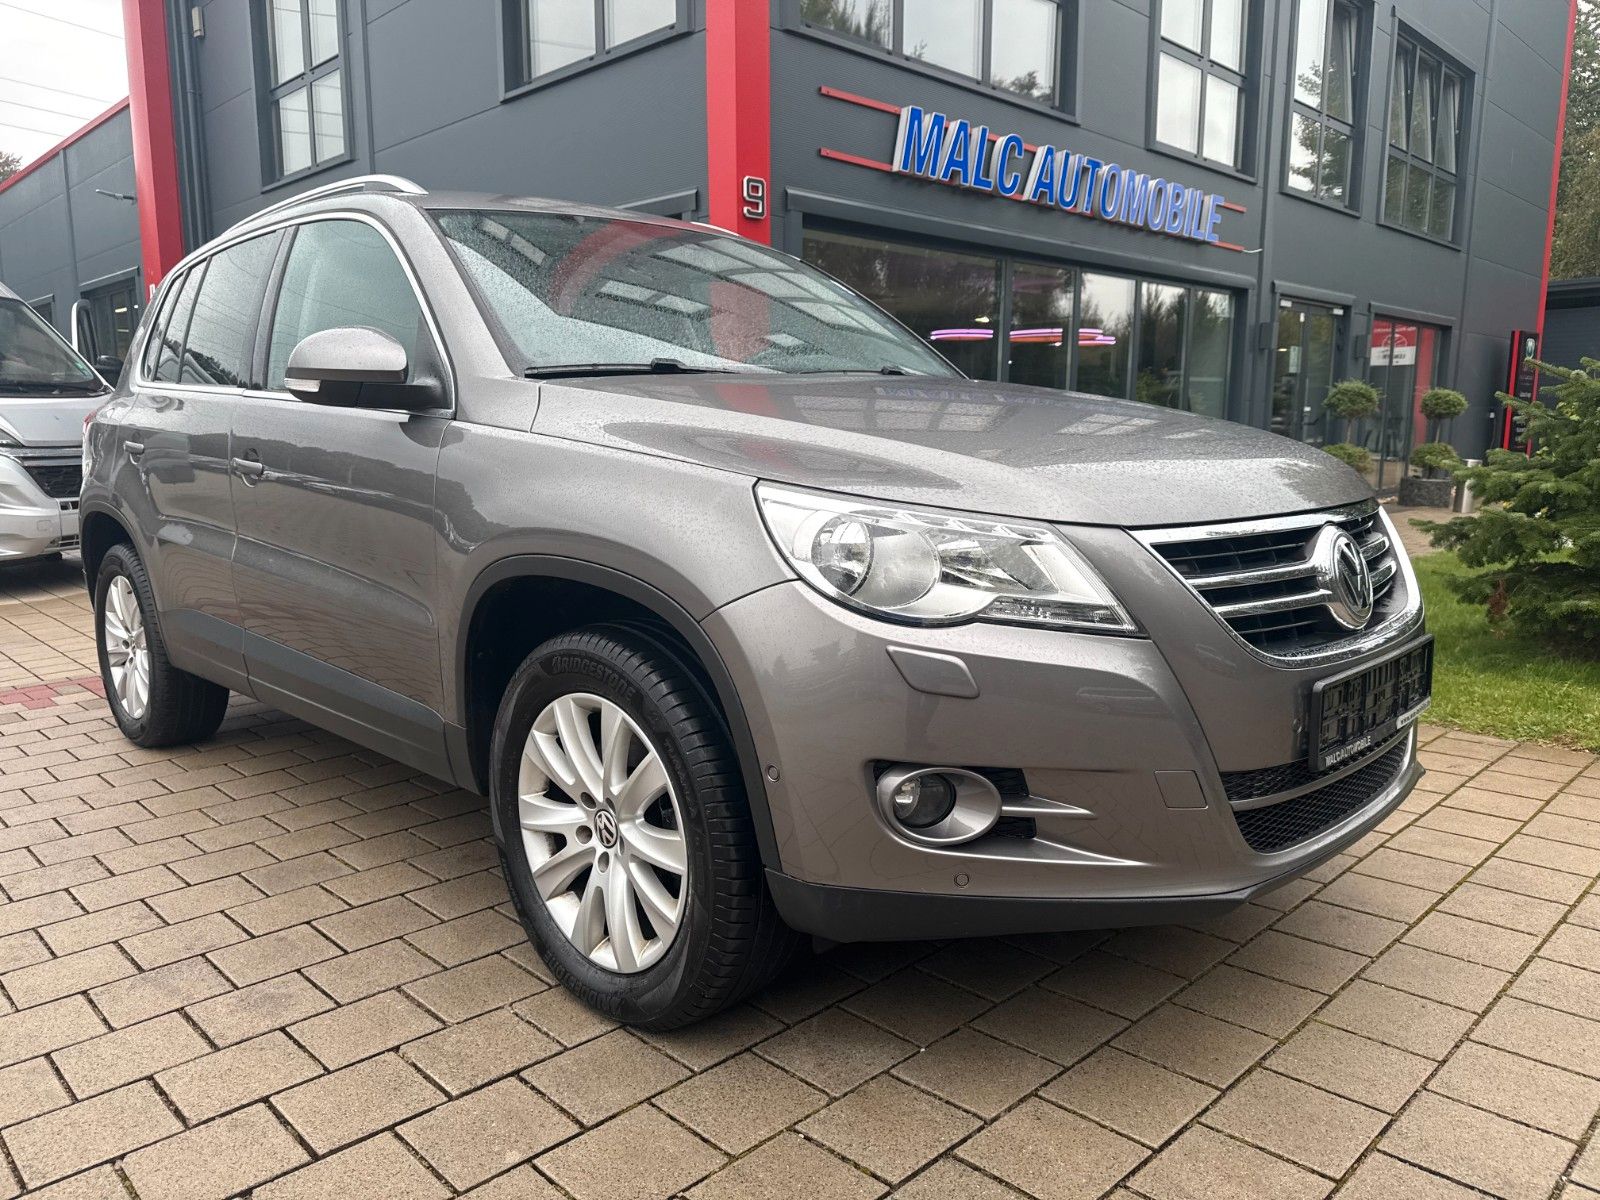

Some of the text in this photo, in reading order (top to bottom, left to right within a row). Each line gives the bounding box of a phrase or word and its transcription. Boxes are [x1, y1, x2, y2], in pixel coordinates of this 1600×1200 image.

[897, 106, 1225, 242] MALC AUTOMOBILE
[743, 175, 767, 220] 9
[551, 655, 636, 701] BRIDGESTONE
